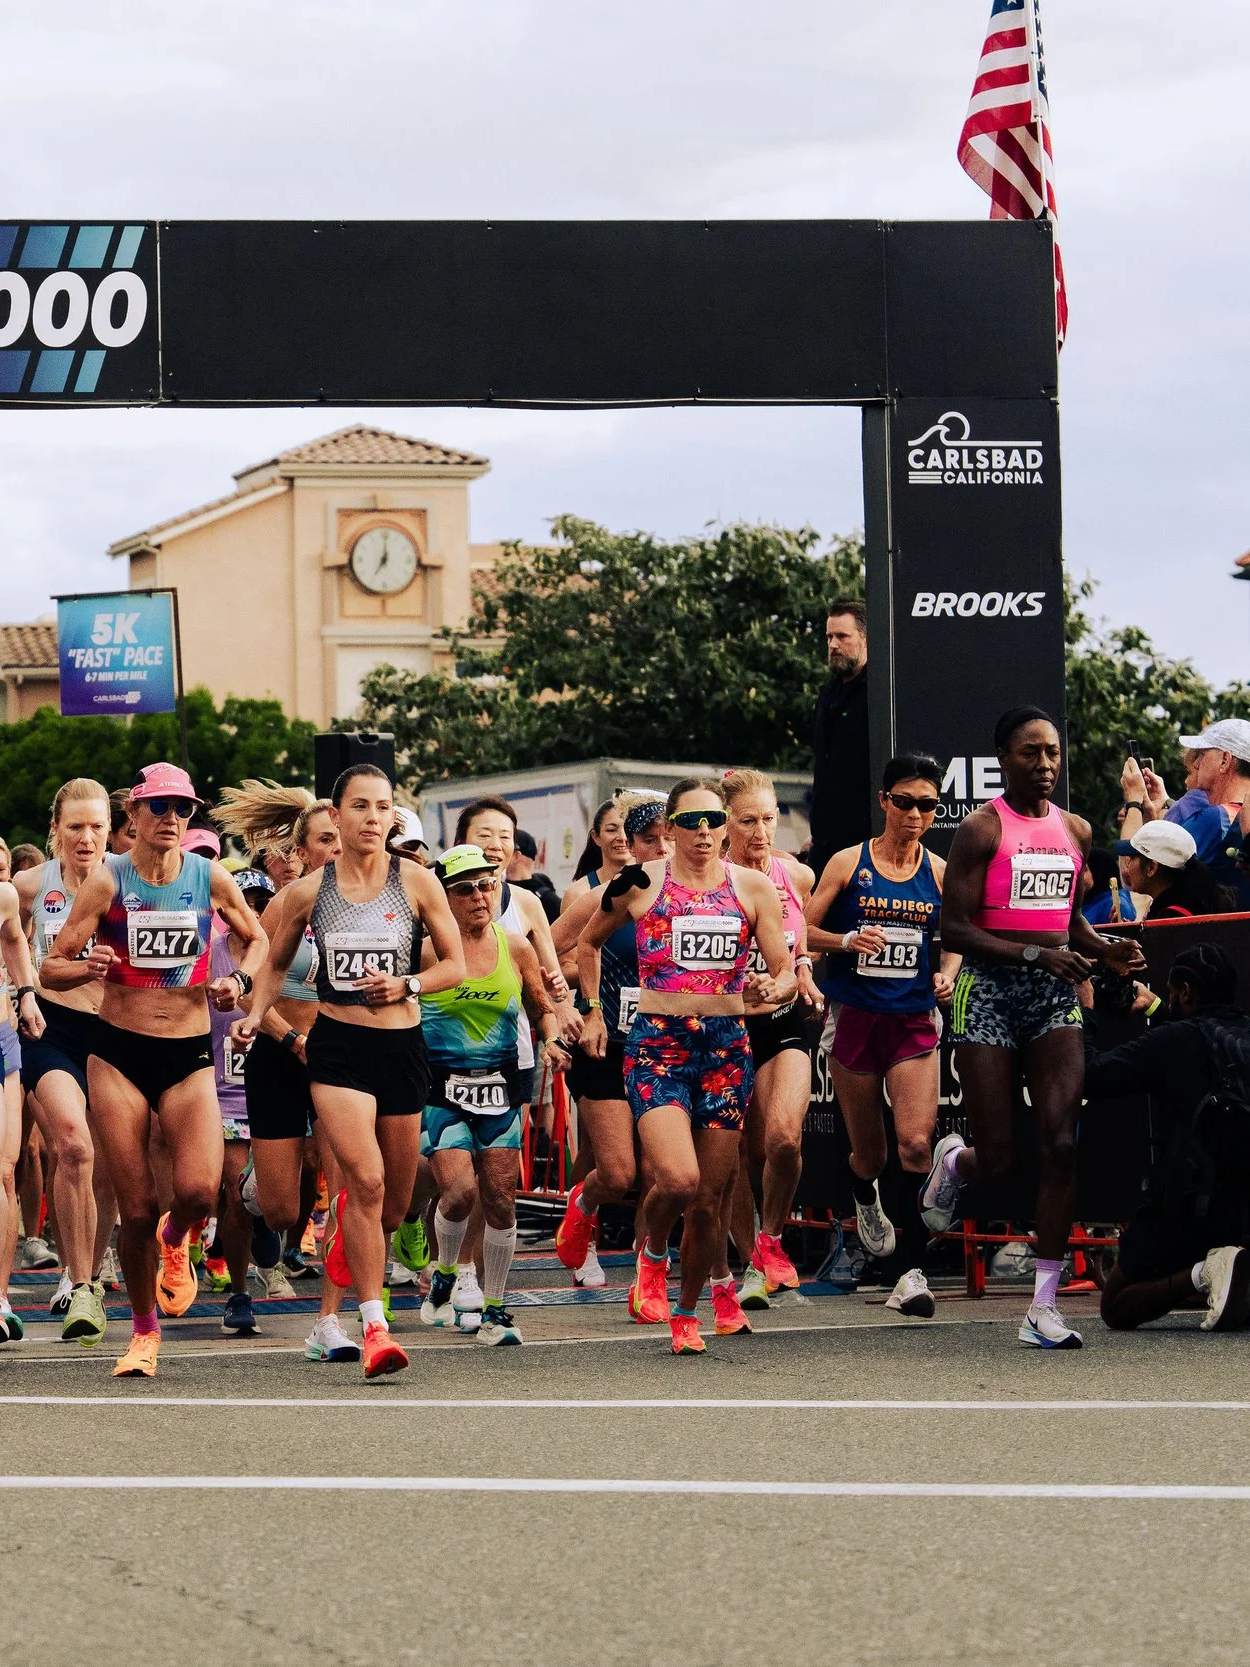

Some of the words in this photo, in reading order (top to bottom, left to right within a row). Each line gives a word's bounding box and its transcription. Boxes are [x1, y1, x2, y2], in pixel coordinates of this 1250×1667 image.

[907, 448, 1044, 470] CARLSBAD
[943, 470, 1044, 485] CALIFORNIA
[910, 591, 1047, 617] BROOKS
[90, 612, 141, 646] 5K
[123, 645, 165, 667] PACE
[97, 671, 114, 682] MIN
[129, 669, 148, 681] MILE
[1020, 872, 1072, 897] 2605
[858, 895, 888, 909] SAN
[892, 898, 934, 914] DIEGO
[863, 908, 900, 919] TRACK
[902, 911, 928, 923] CLUB
[138, 930, 196, 955] 2477
[682, 933, 738, 959] 3205
[335, 952, 394, 978] 2483
[867, 944, 918, 968] 2193
[771, 1004, 791, 1020] NIKE
[455, 1085, 505, 1107] 2110
